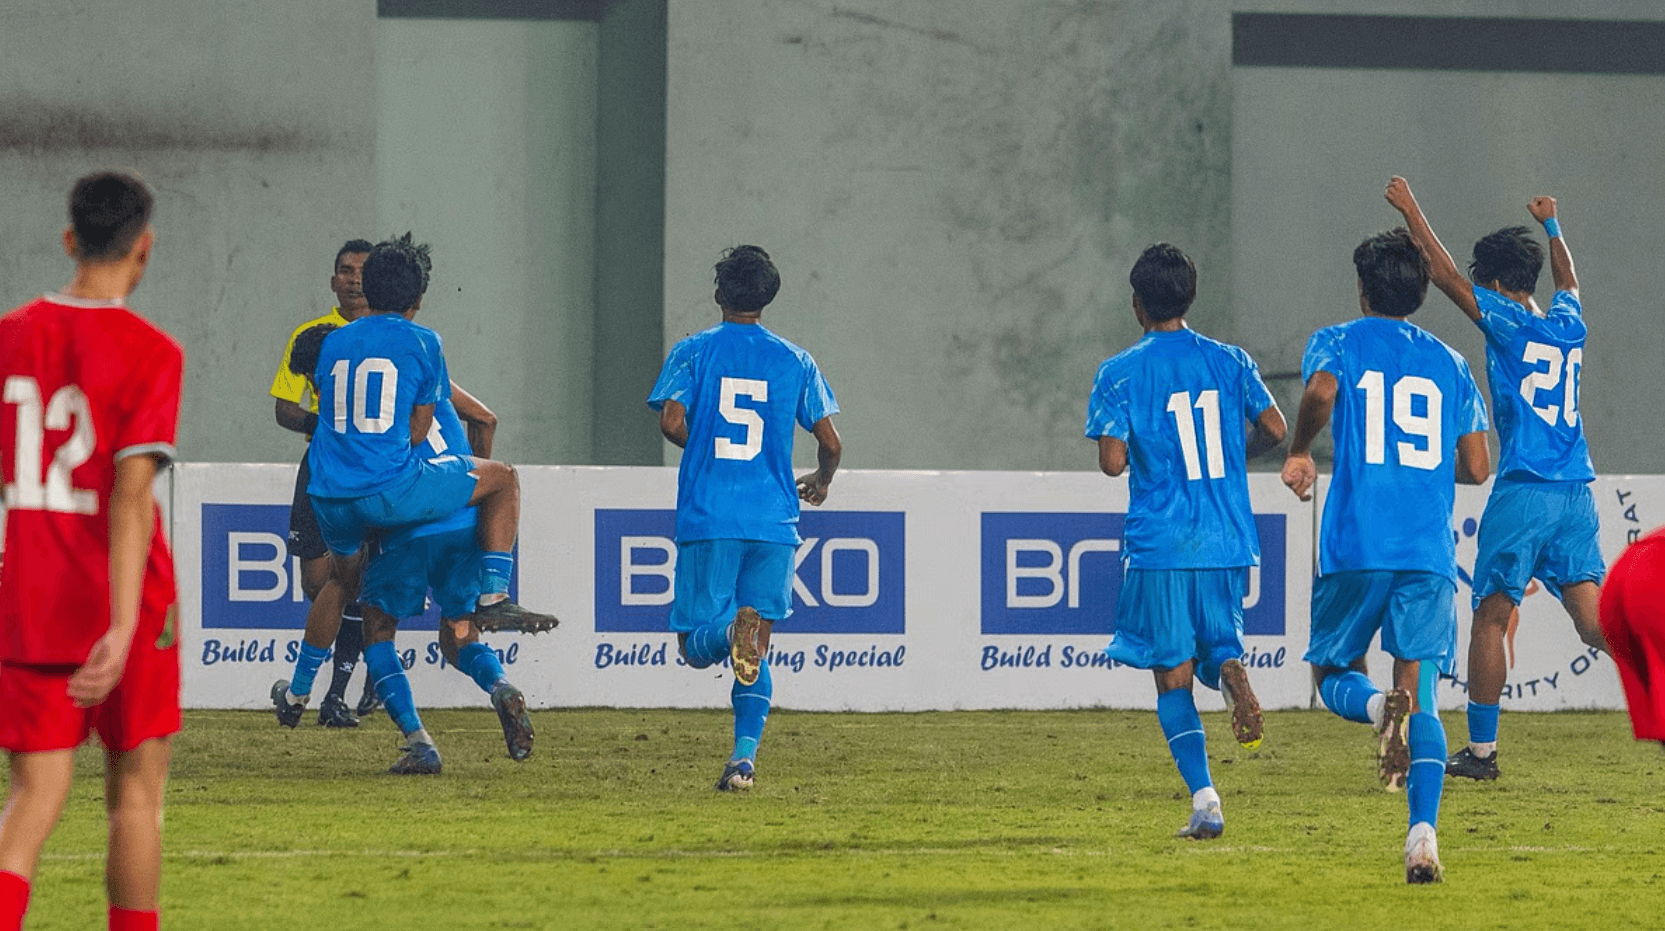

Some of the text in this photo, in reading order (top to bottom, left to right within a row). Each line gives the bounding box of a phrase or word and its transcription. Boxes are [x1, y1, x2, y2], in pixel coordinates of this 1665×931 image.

[330, 357, 399, 435] 10
[715, 377, 768, 461] 5
[1166, 389, 1226, 481] 11
[1357, 370, 1443, 471] 19
[4, 374, 99, 516] 12
[202, 639, 276, 665] Build
[594, 642, 668, 669] Build
[813, 644, 906, 672] Special
[980, 644, 1052, 671] Build
[1240, 646, 1287, 669] cial
